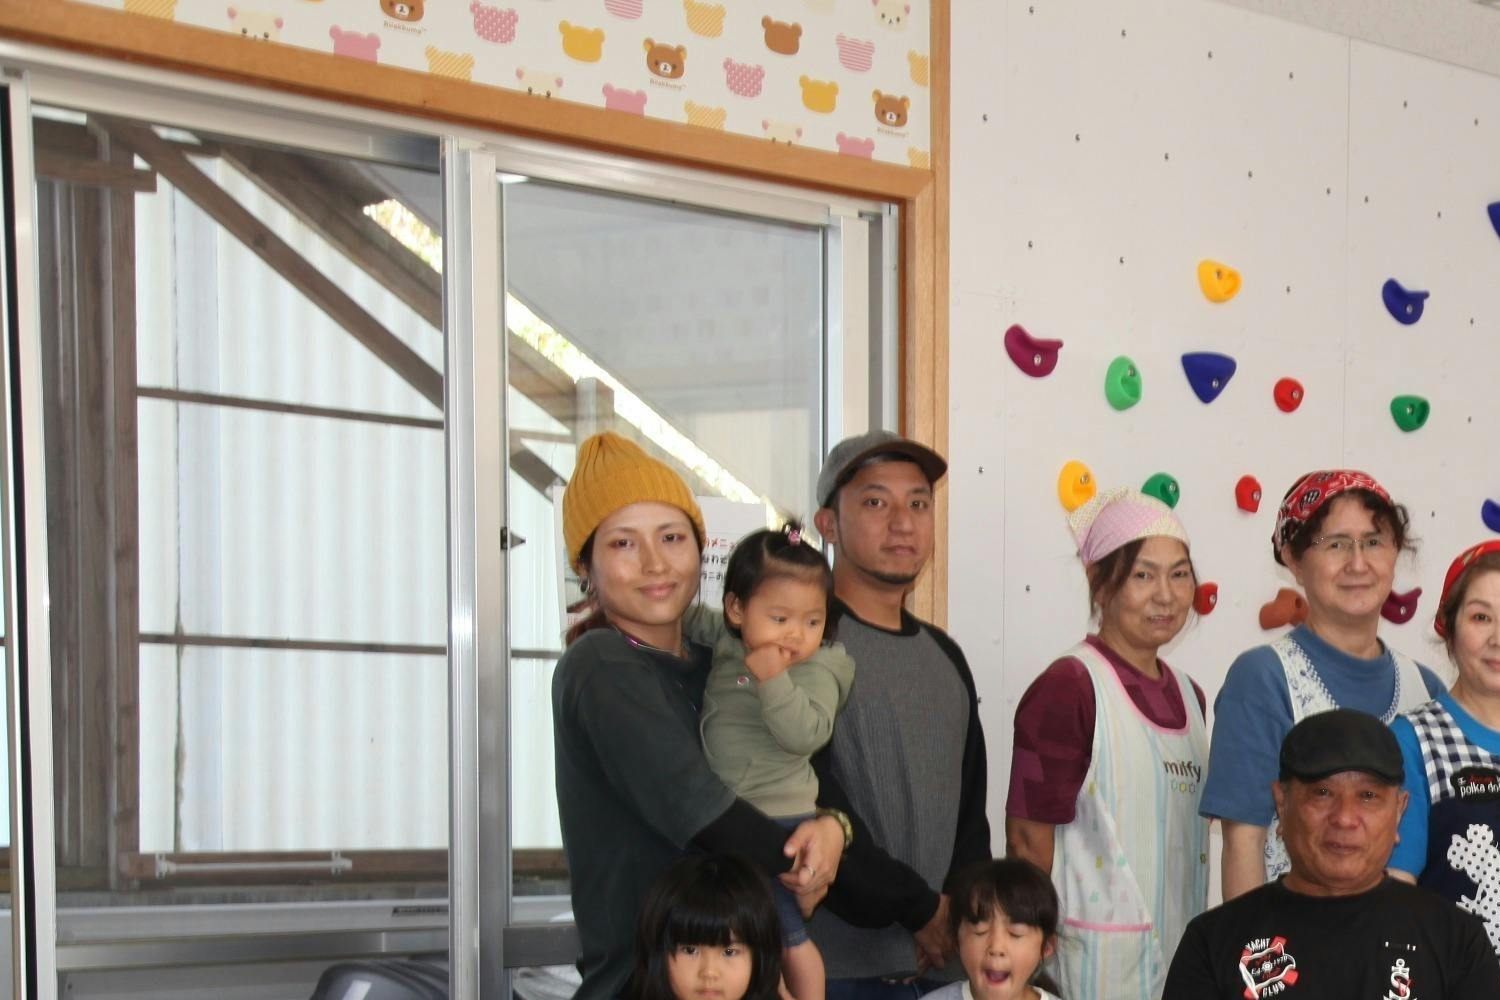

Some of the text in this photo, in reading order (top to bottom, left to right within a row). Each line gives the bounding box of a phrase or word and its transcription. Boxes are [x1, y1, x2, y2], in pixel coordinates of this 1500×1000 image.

[1163, 760, 1201, 783] miffy
[1460, 782, 1485, 798] polka
[1262, 980, 1286, 999] CLUB
